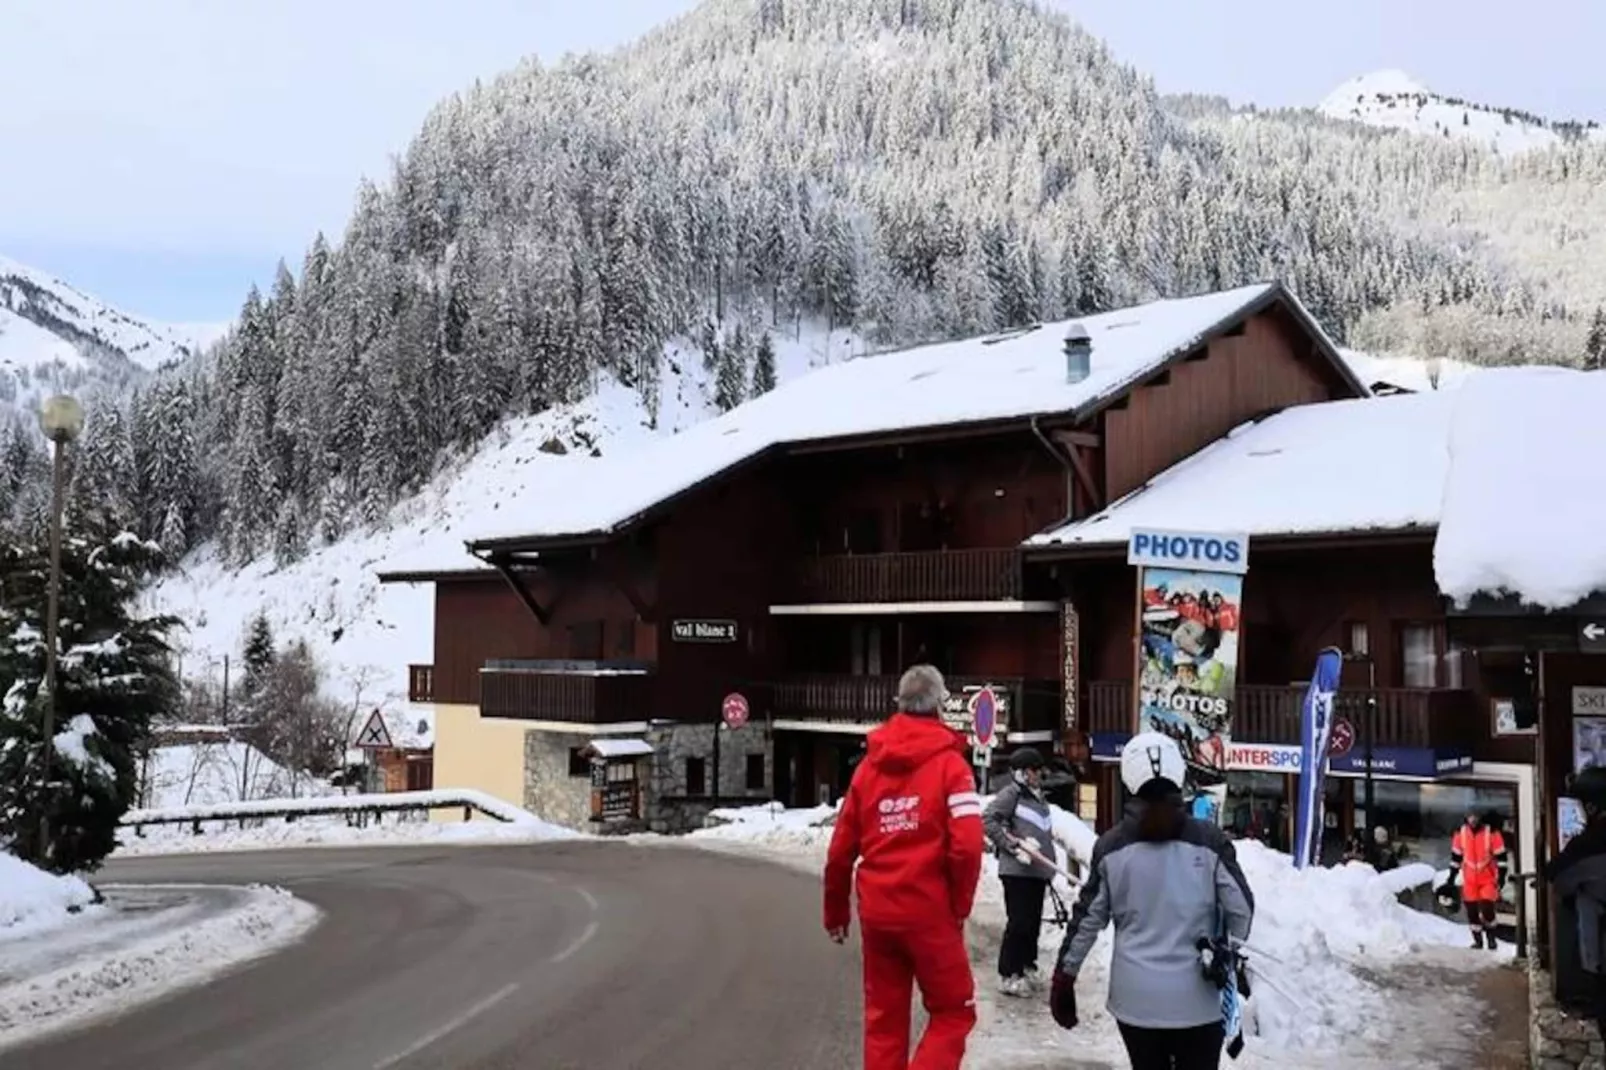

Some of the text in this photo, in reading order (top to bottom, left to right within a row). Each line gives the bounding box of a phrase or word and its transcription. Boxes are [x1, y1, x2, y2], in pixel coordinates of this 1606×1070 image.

[1134, 533, 1240, 563] PHOTOS
[1065, 602, 1075, 729] RESTAURANT
[1144, 692, 1229, 716] PHOTOS
